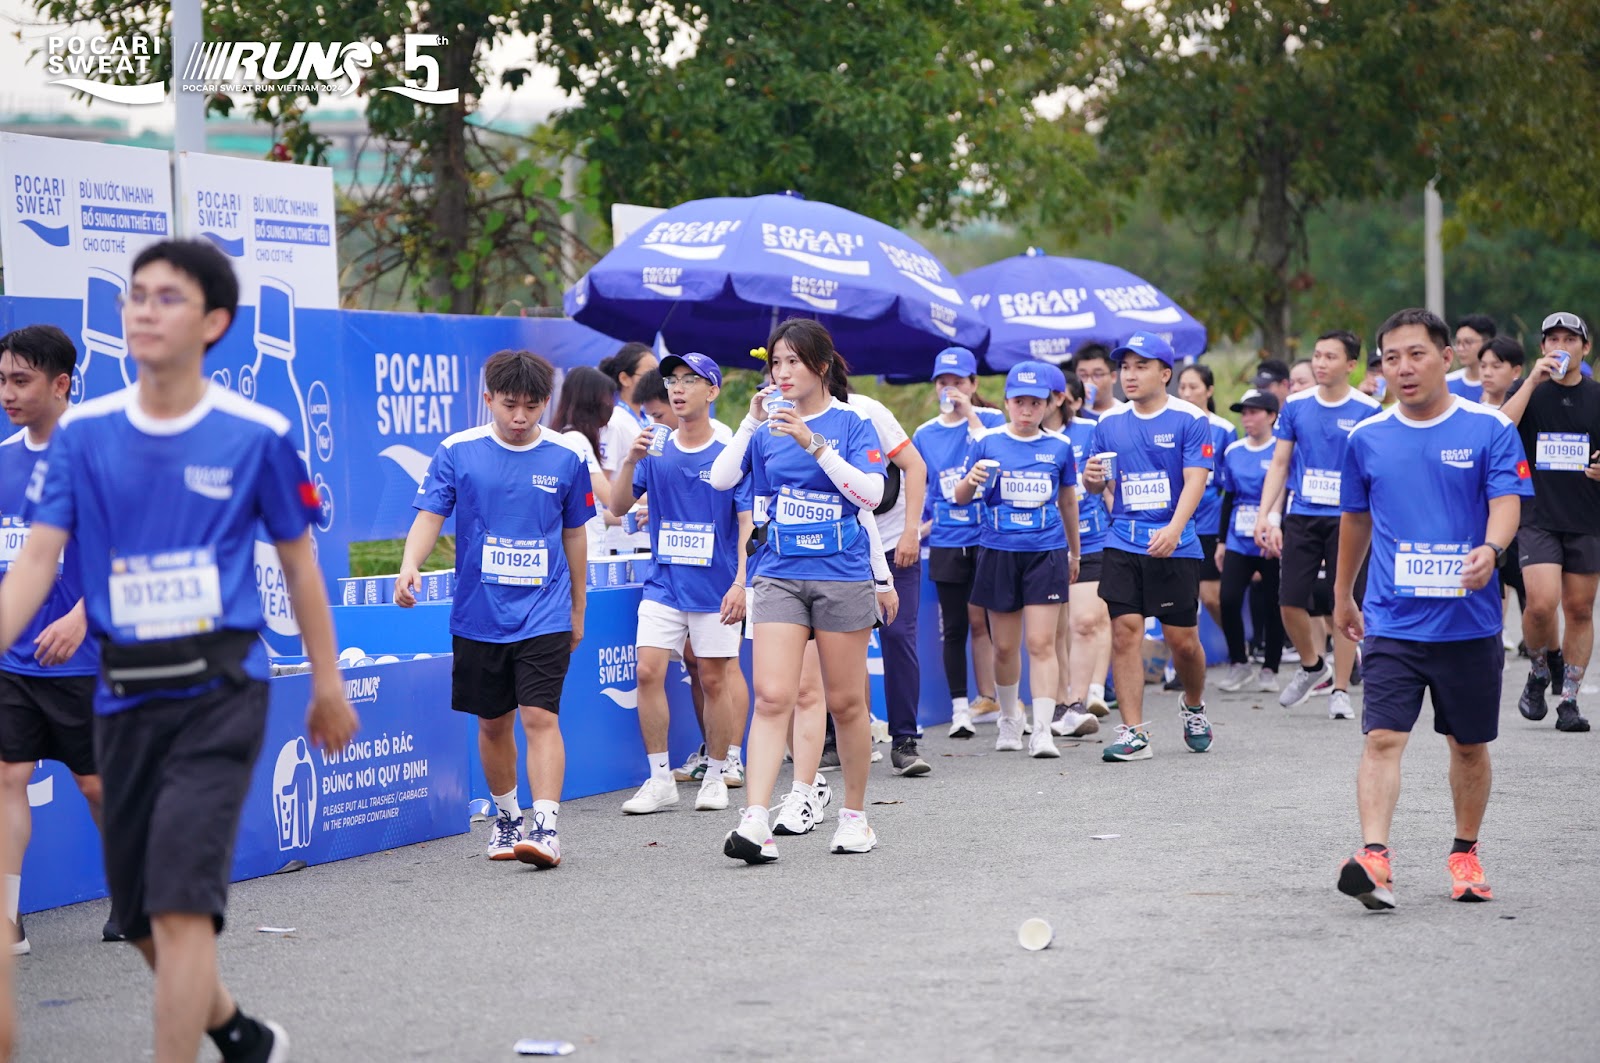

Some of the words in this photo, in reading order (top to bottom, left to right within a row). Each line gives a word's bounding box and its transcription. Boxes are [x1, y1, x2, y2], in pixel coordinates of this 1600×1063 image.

[14, 174, 65, 197] POCARI
[79, 178, 92, 199] BÙ
[94, 181, 120, 203] NƯỚC
[121, 186, 154, 204] NHANH
[16, 195, 61, 216] SWEAT
[197, 190, 241, 211] POCARI
[253, 195, 264, 213] BÙ
[265, 194, 289, 215] NƯỚC
[290, 200, 318, 217] NHANH
[94, 213, 115, 229] SUNG
[116, 214, 130, 230] ION
[130, 211, 151, 231] THIẾT
[198, 209, 238, 229] SWEAT
[652, 220, 742, 233] POCARI
[266, 225, 284, 240] SUNG
[644, 230, 729, 243] SWEAT
[762, 223, 864, 247] POCARI
[83, 237, 99, 252] CHO
[100, 239, 110, 252] CƠ
[763, 235, 855, 256] SWEAT
[256, 248, 271, 262] CHO
[642, 274, 677, 284] SWEAT
[792, 275, 838, 291] POCARI
[791, 284, 833, 297] SWEAT
[998, 288, 1087, 306] POCARI
[1001, 300, 1079, 317] SWEAT
[375, 353, 459, 393] POCARI
[377, 395, 453, 435] SWEAT
[1544, 444, 1584, 456] 101960
[1005, 482, 1047, 494] 100449
[783, 501, 834, 521] 100599
[666, 534, 705, 549] 101921
[490, 551, 541, 567] 101924
[1405, 559, 1463, 575] 102172
[255, 564, 289, 592] OCA
[598, 644, 638, 667] POCARI
[599, 662, 636, 685] SWEAT
[342, 740, 371, 764] LÒNG
[375, 732, 390, 757] BỎ
[392, 731, 413, 755] RÁC
[322, 771, 354, 796] ĐÚNG
[355, 766, 376, 788] NƠI
[377, 763, 400, 788] QUY
[402, 759, 428, 784] ĐỊNH
[323, 803, 345, 816] PLEASE
[345, 801, 357, 813] PUT
[357, 798, 369, 810] ALL
[369, 795, 395, 809] TRASHES
[399, 787, 428, 804] GARBAGES
[322, 820, 330, 832] IN
[330, 818, 342, 830] THE
[342, 813, 366, 828] PROPER
[367, 807, 400, 824] CONTAINER
